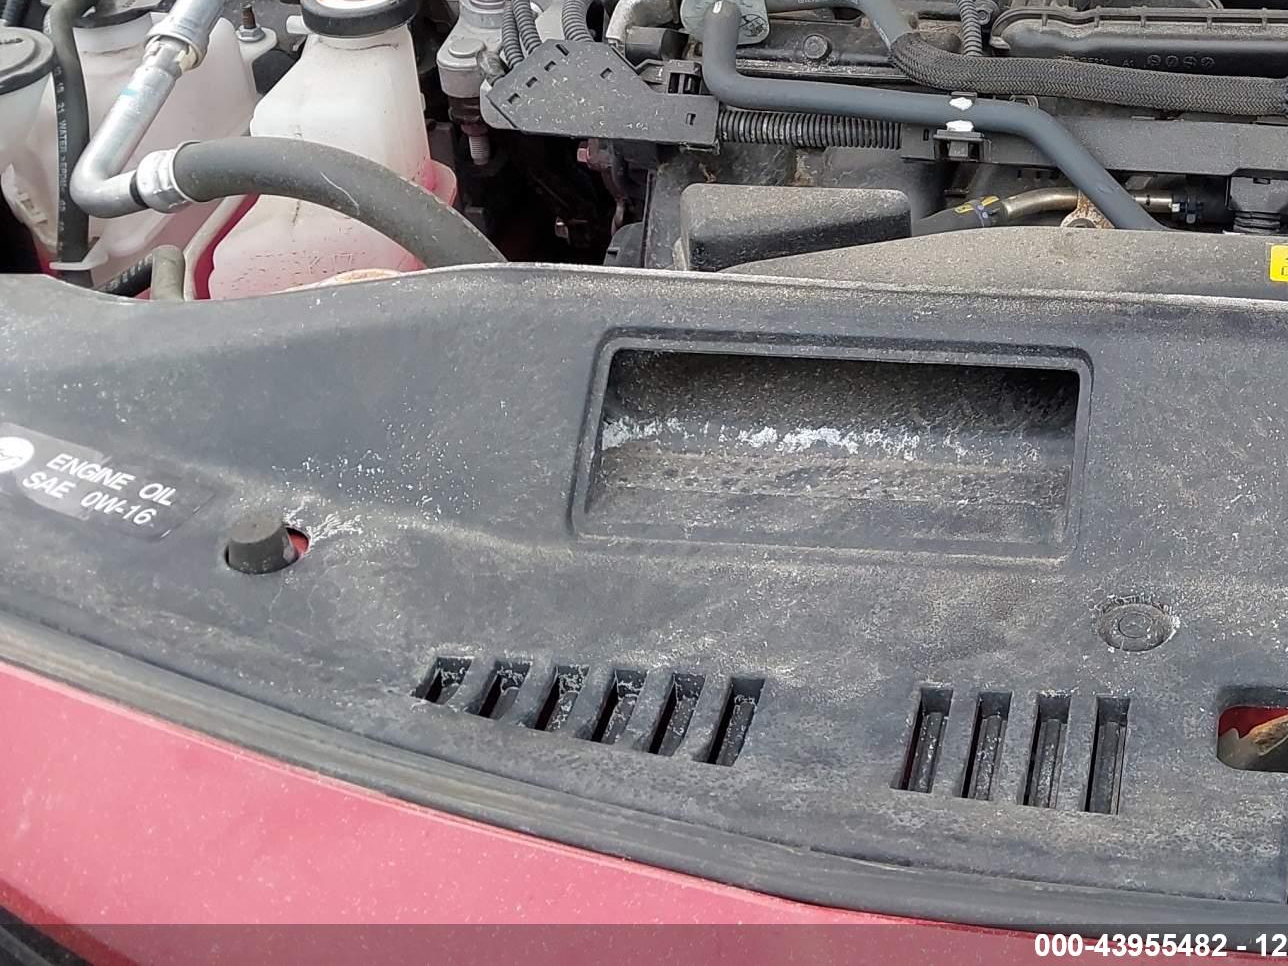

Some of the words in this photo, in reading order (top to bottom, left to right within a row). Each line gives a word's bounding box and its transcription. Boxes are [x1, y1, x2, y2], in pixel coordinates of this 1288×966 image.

[59, 120, 67, 152] WATER
[22, 471, 77, 499] SAE
[80, 491, 157, 525] 0W-16
[46, 453, 136, 491] ENGINE
[139, 483, 177, 506] OIL
